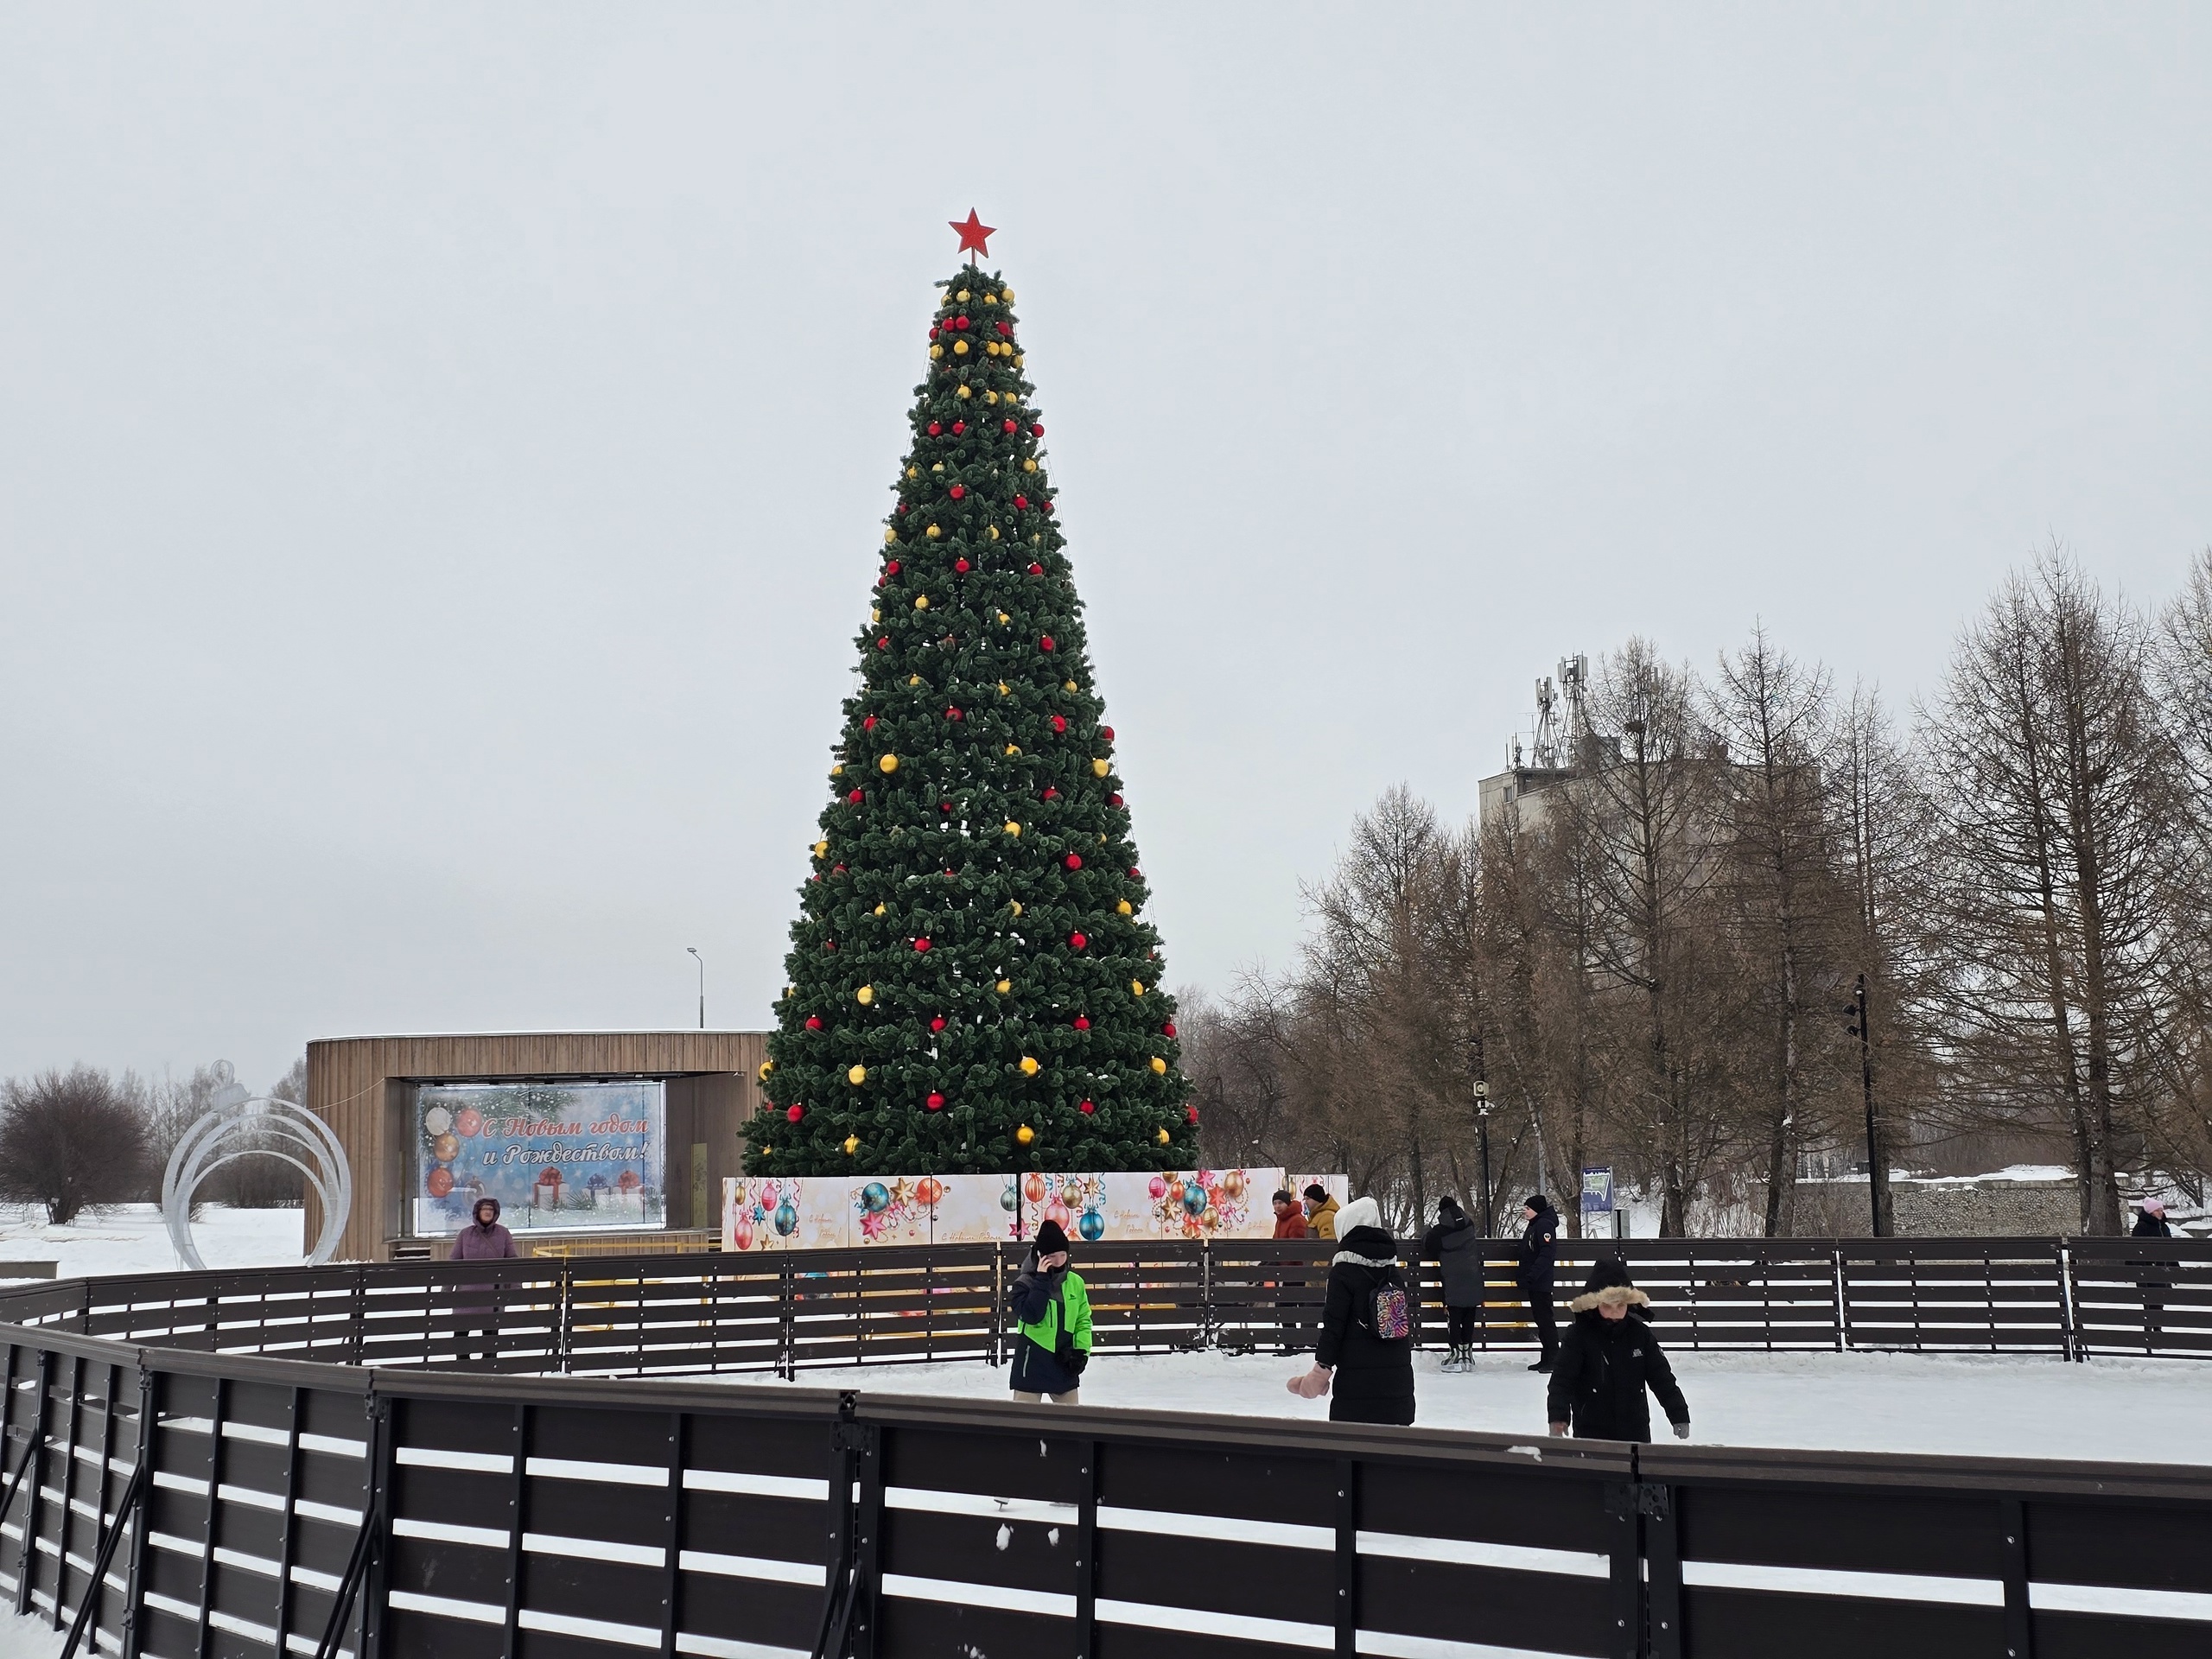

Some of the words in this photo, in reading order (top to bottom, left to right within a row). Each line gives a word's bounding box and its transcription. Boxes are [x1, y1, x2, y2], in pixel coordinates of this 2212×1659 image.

[483, 1118, 497, 1138] С
[503, 1117, 582, 1137] Новым
[588, 1112, 649, 1135] годом
[483, 1151, 498, 1166] и
[502, 1141, 651, 1165] Рождеством!
